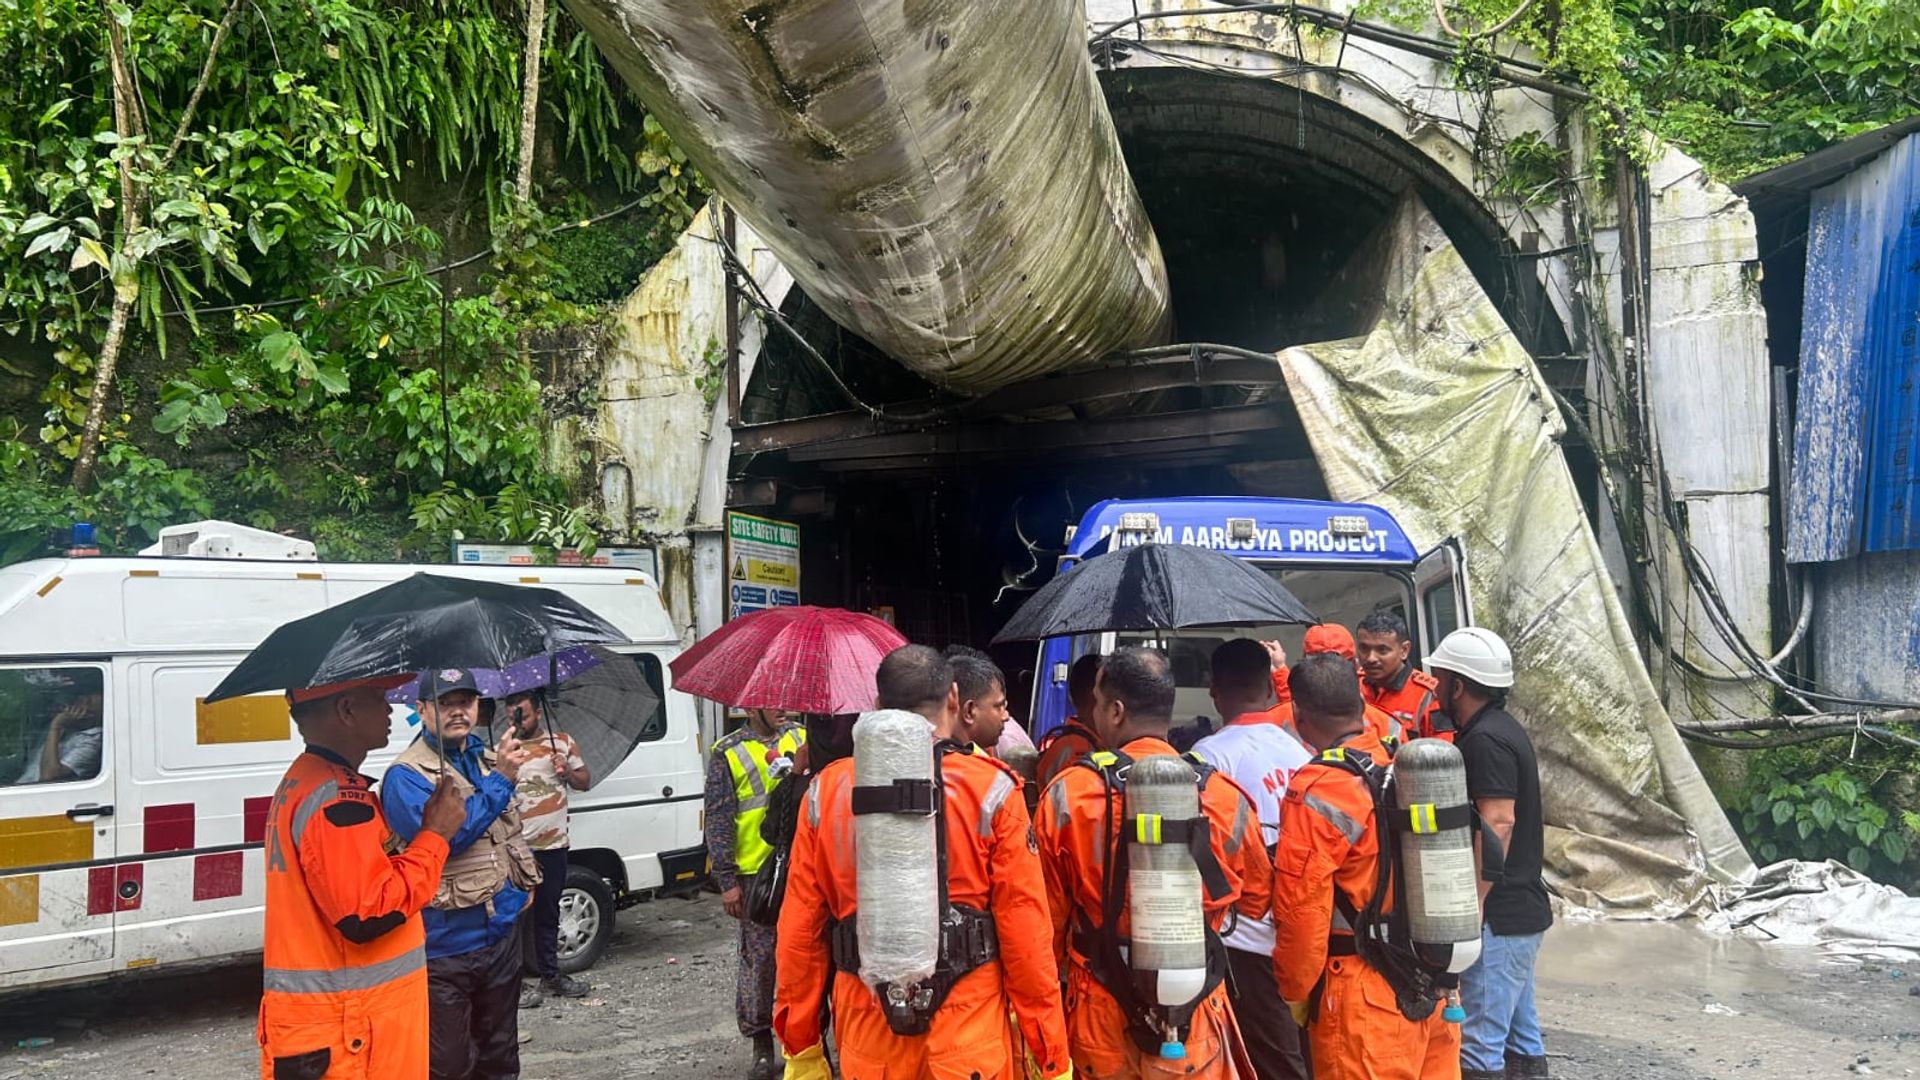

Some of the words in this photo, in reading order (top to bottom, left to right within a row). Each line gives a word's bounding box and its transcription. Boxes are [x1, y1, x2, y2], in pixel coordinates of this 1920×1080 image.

[732, 517, 751, 536] SITE
[752, 521, 778, 542] SAFETY
[1289, 529, 1387, 552] PROJECT
[340, 791, 366, 801] NDRF
